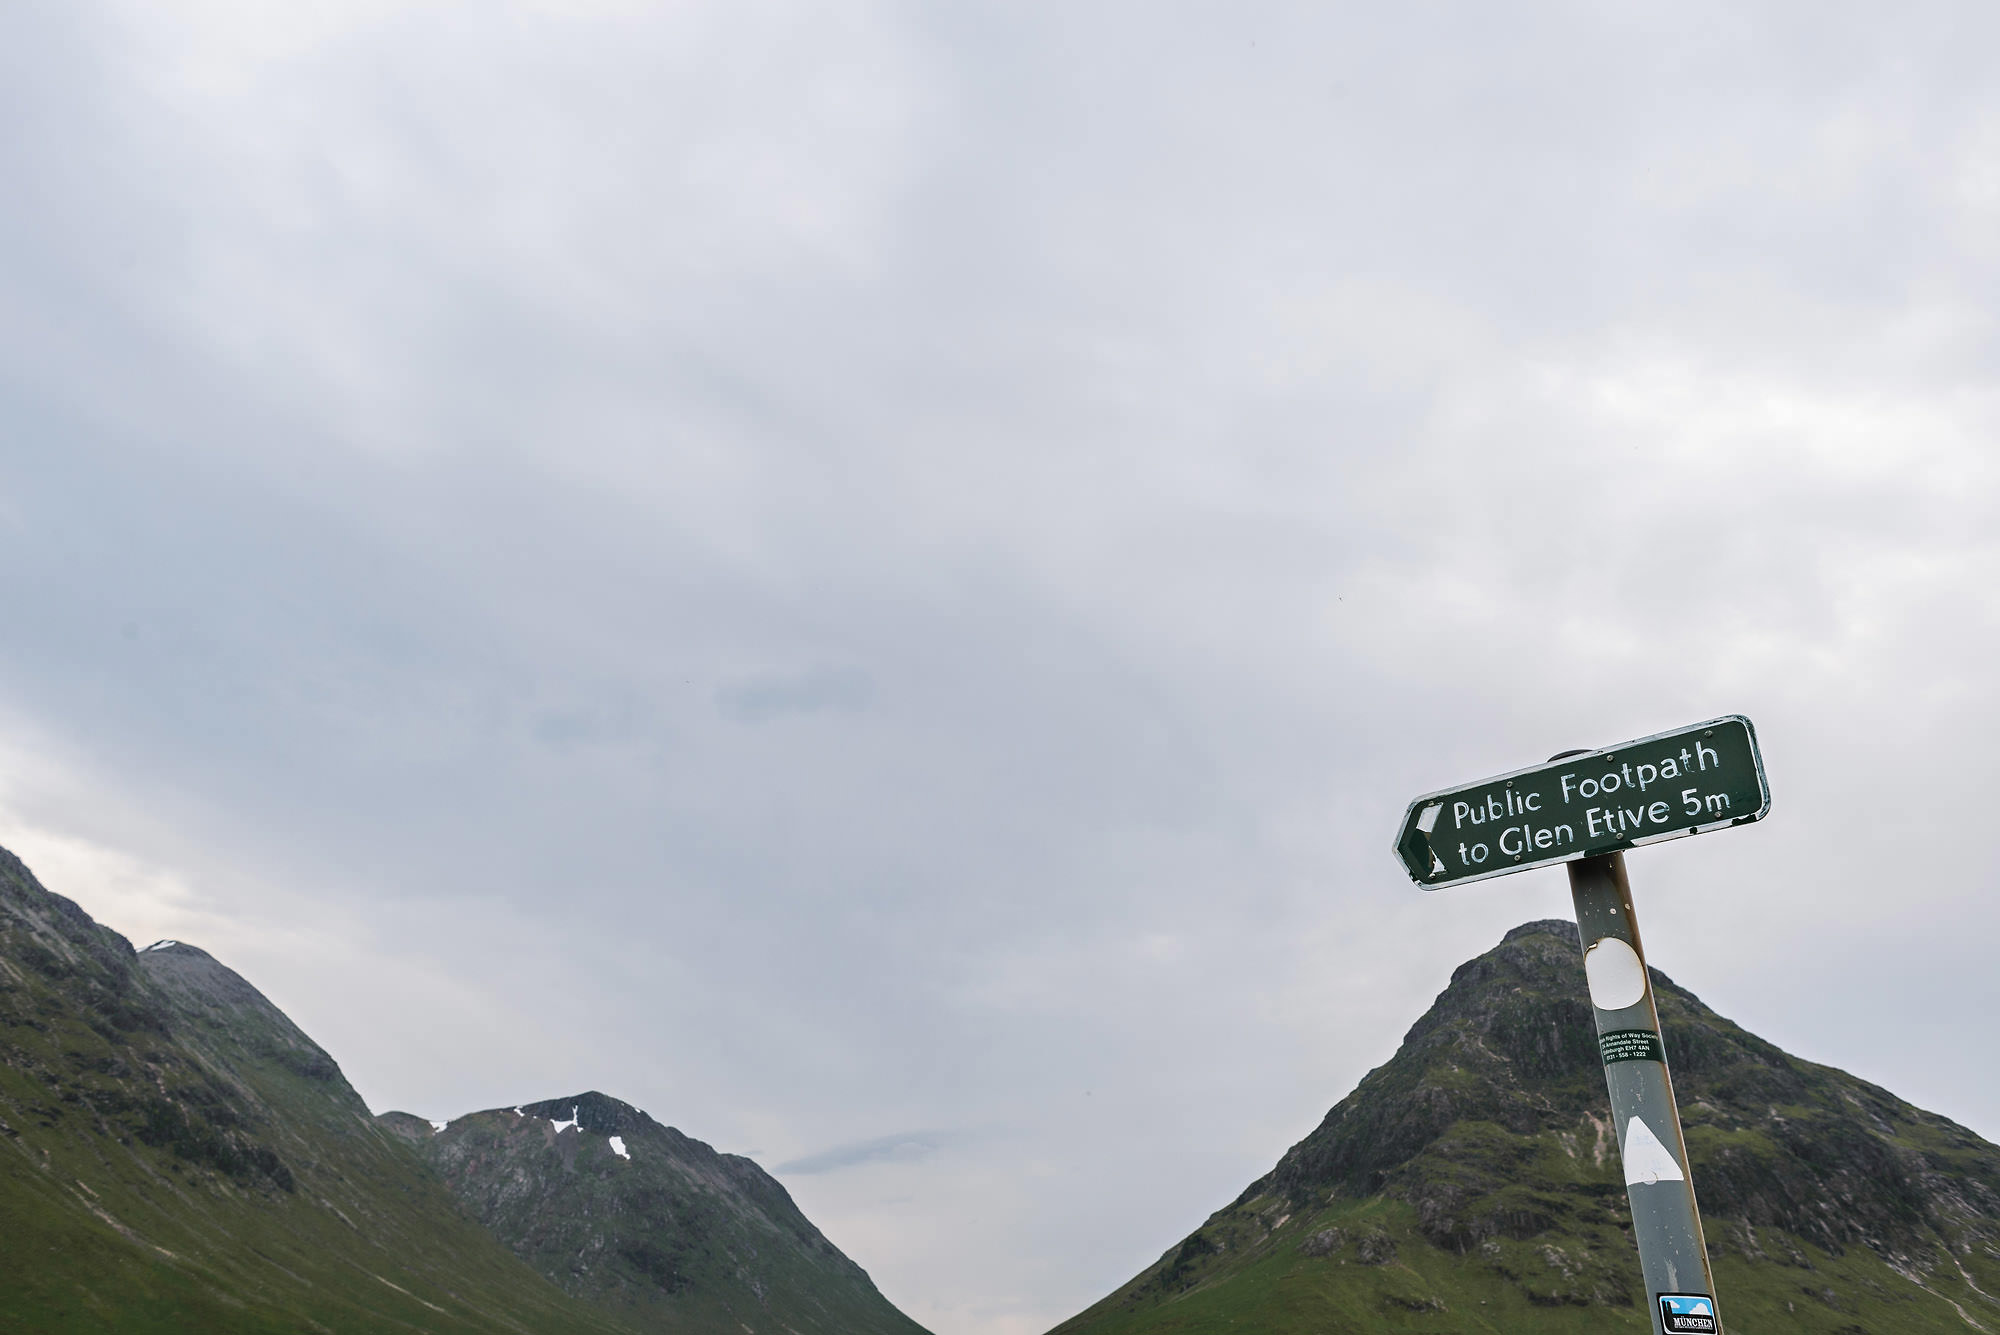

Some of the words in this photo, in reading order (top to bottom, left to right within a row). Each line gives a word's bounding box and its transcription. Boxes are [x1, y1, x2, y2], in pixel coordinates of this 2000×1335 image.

[1453, 789, 1540, 829] Public
[1560, 740, 1719, 803] Footpath
[1458, 840, 1489, 866] to
[1499, 823, 1575, 857] Glen
[1585, 800, 1671, 838] Etive
[1681, 788, 1731, 816] 5m
[1673, 1316, 1712, 1328] MÜNCHEN
